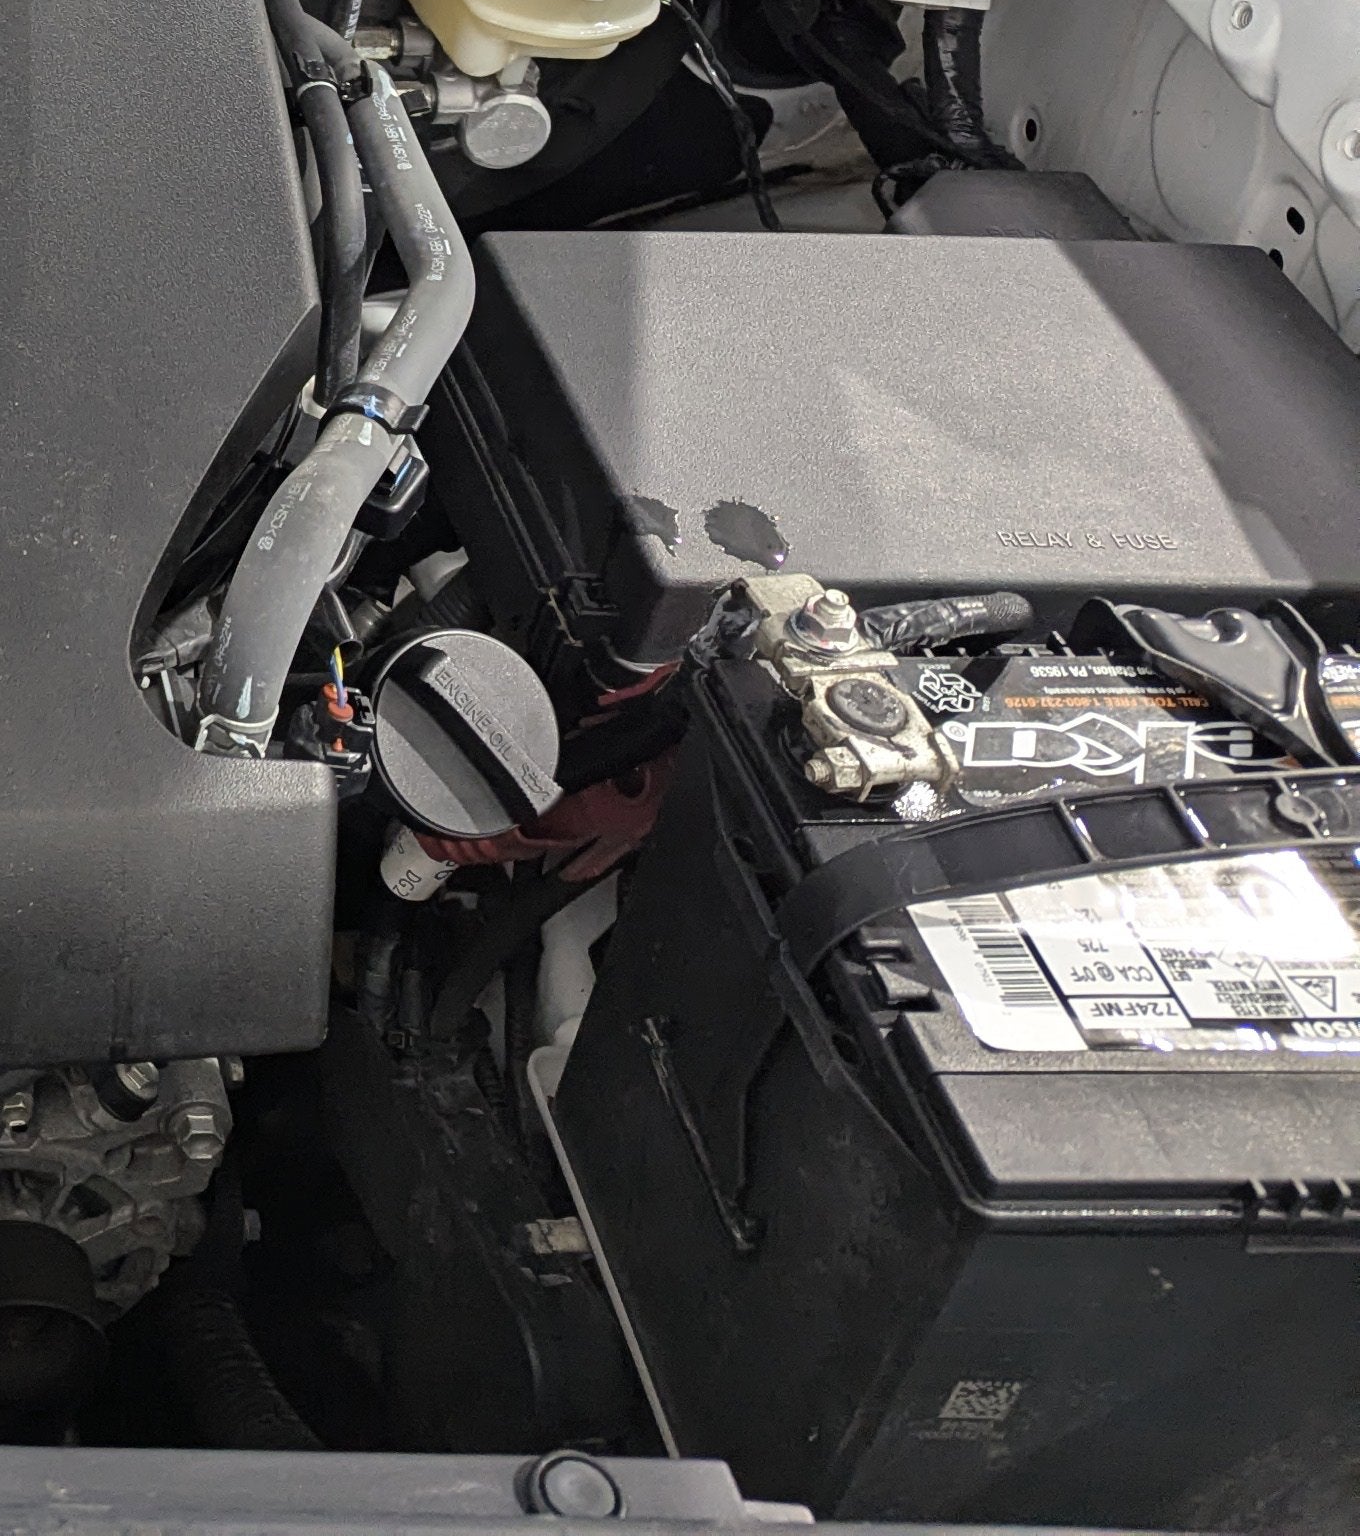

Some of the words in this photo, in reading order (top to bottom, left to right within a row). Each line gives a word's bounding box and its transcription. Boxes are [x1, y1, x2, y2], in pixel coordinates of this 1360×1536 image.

[996, 530, 1074, 548] RELAY
[1084, 532, 1106, 550] &
[1111, 532, 1179, 551] FUSE
[1031, 665, 1068, 678] 19536
[1071, 665, 1089, 678] PA
[1088, 664, 1138, 678] Station,
[1104, 695, 1139, 708] FREE
[434, 666, 491, 734] ENGINE
[489, 729, 513, 763] OIL
[1093, 961, 1116, 982] @
[1122, 965, 1154, 982] CCA
[1089, 1001, 1179, 1017] 724FMF
